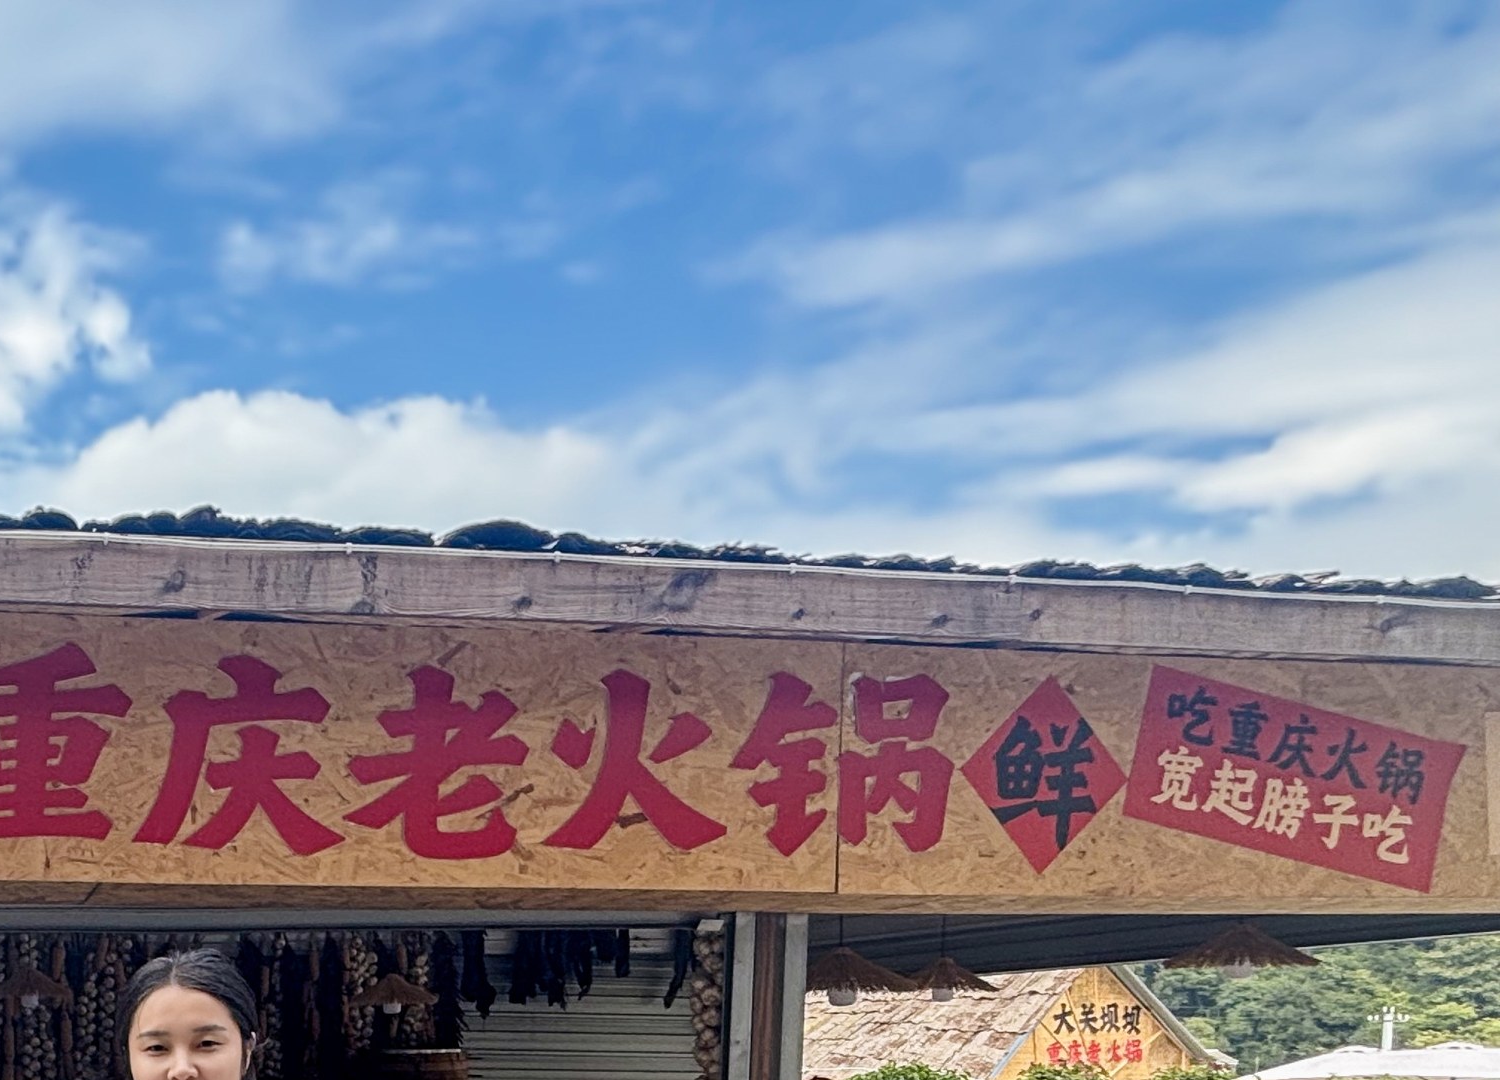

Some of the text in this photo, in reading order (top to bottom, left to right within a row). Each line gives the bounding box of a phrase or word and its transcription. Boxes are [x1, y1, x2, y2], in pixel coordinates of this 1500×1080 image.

[991, 715, 1097, 852] 鲜
[1166, 685, 1426, 805] 吃重庆火锅
[1150, 746, 1413, 865] 宽起膀子吃
[1046, 1039, 1144, 1066] 重庆老火锅
[1052, 1002, 1143, 1036] 大关坝坝
